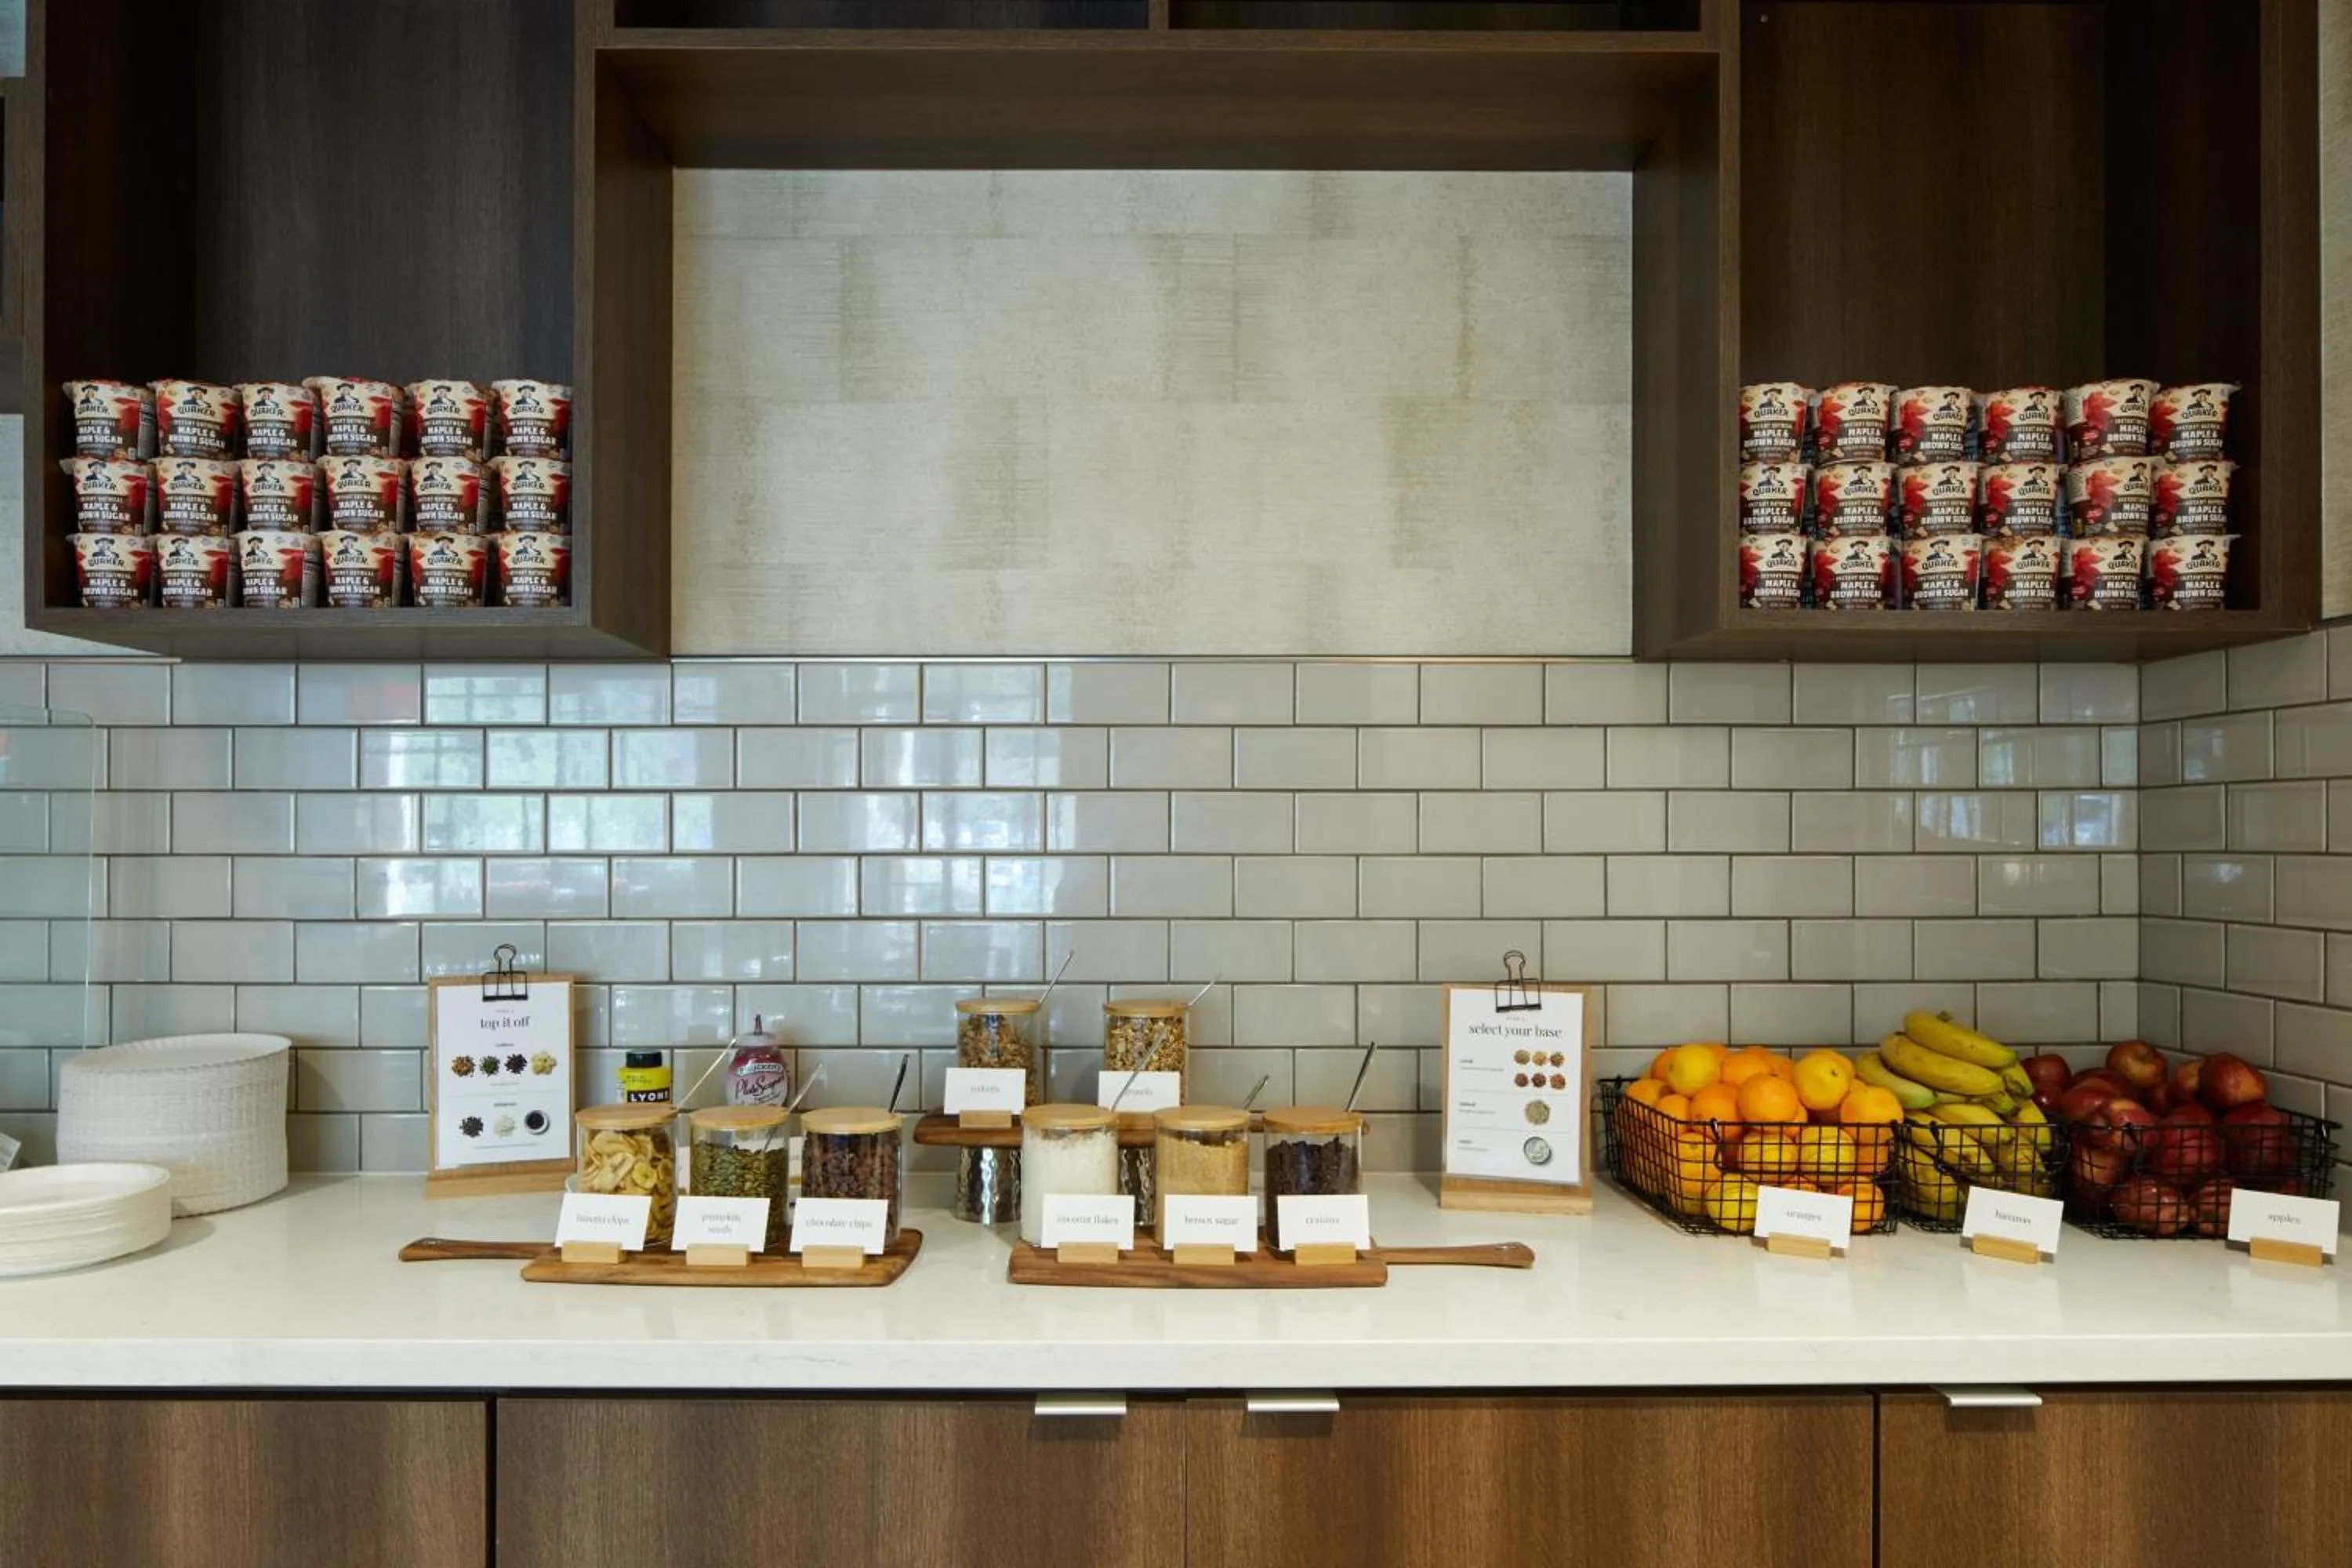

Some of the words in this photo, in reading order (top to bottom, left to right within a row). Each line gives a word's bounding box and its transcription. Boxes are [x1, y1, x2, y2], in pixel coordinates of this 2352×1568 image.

[79, 426, 101, 434] MAPLE
[178, 426, 209, 437] MAPLE
[332, 424, 359, 433] MAPLE
[427, 426, 454, 435] MAPLE
[1753, 429, 1780, 437] MAPLE
[1848, 428, 1873, 437] MAPLE
[1931, 433, 1956, 441] MAPLE
[2017, 433, 2043, 441] MAPLE
[1752, 507, 1780, 516] MAPLE
[1843, 506, 1869, 515] MAPLE
[1932, 506, 1958, 515] MAPLE
[1765, 579, 1791, 587] MAPLE
[1840, 581, 1867, 590] MAPLE
[1922, 580, 1950, 590] MAPLE
[2016, 580, 2042, 589] MAPLE
[2186, 580, 2213, 589] MAPLE
[1468, 1022, 1501, 1035] select
[1504, 1026, 1533, 1037] your
[1534, 1024, 1563, 1038] base
